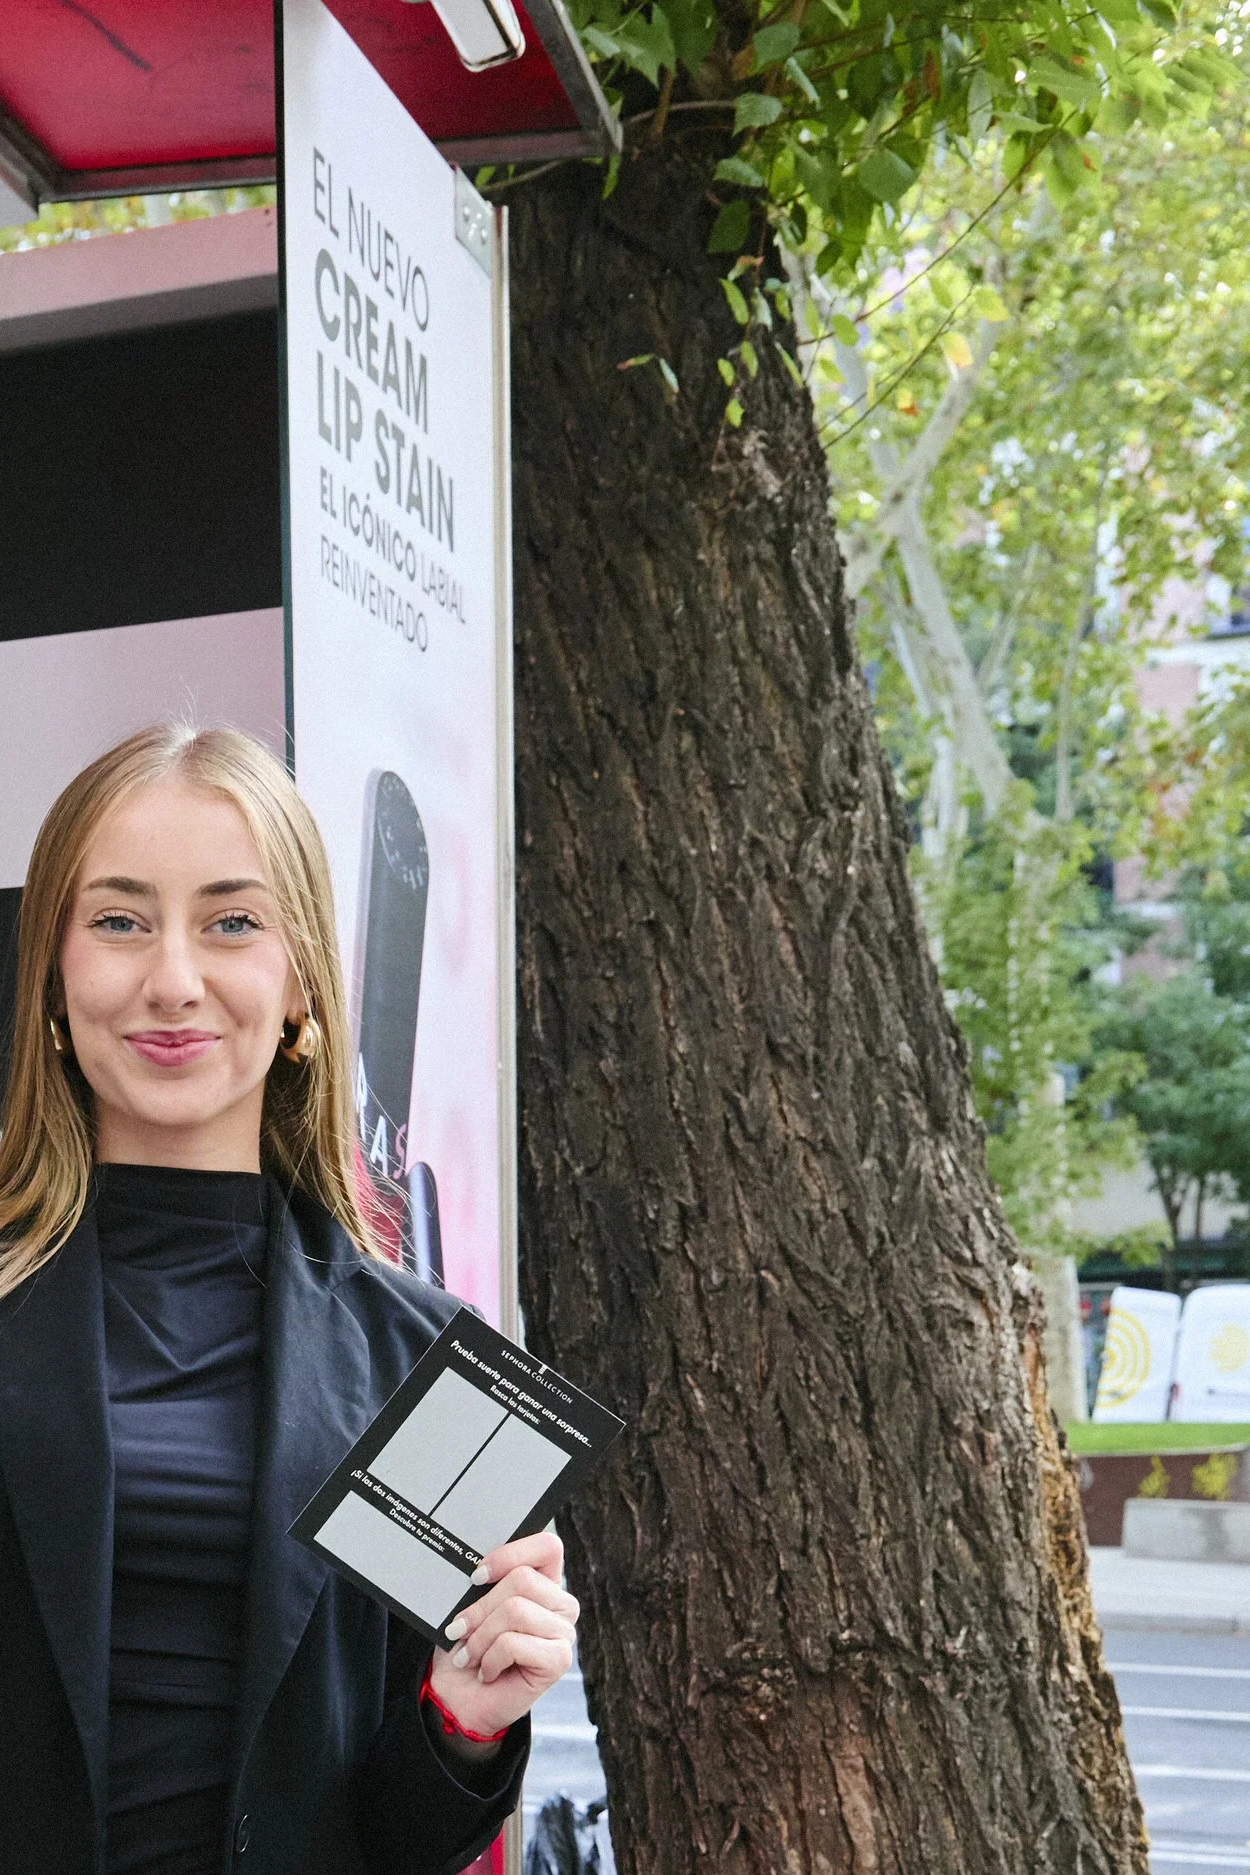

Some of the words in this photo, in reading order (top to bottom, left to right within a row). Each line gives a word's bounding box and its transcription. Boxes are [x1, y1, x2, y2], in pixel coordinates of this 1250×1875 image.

[313, 146, 340, 241] EL
[348, 186, 430, 333] NUEVO
[314, 247, 429, 435] CREAM
[316, 350, 363, 464] LIP
[374, 407, 455, 553] STAIN
[320, 466, 338, 519] EL
[342, 484, 417, 582] ICÓNICO
[420, 545, 466, 625] LABIAL
[321, 534, 429, 653] REINVENTADO
[451, 1340, 479, 1364] Prueba
[477, 1361, 501, 1381] suerte
[499, 1378, 520, 1395] para
[517, 1391, 543, 1410] ganar
[542, 1408, 557, 1421] una
[556, 1418, 592, 1448] sorpresa...
[490, 1384, 509, 1401] Rasca
[507, 1396, 518, 1408] las
[501, 1350, 532, 1375] SEPHORA
[531, 1372, 574, 1405] COLLECTION
[350, 1469, 364, 1480] ¡Si
[362, 1476, 374, 1488] las
[372, 1484, 386, 1497] dos
[385, 1493, 417, 1520] imágenes
[417, 1518, 431, 1529] son
[430, 1527, 464, 1555] diferentes,
[389, 1508, 417, 1532] Descubre
[416, 1528, 424, 1537] tu
[422, 1533, 446, 1552] premio:
